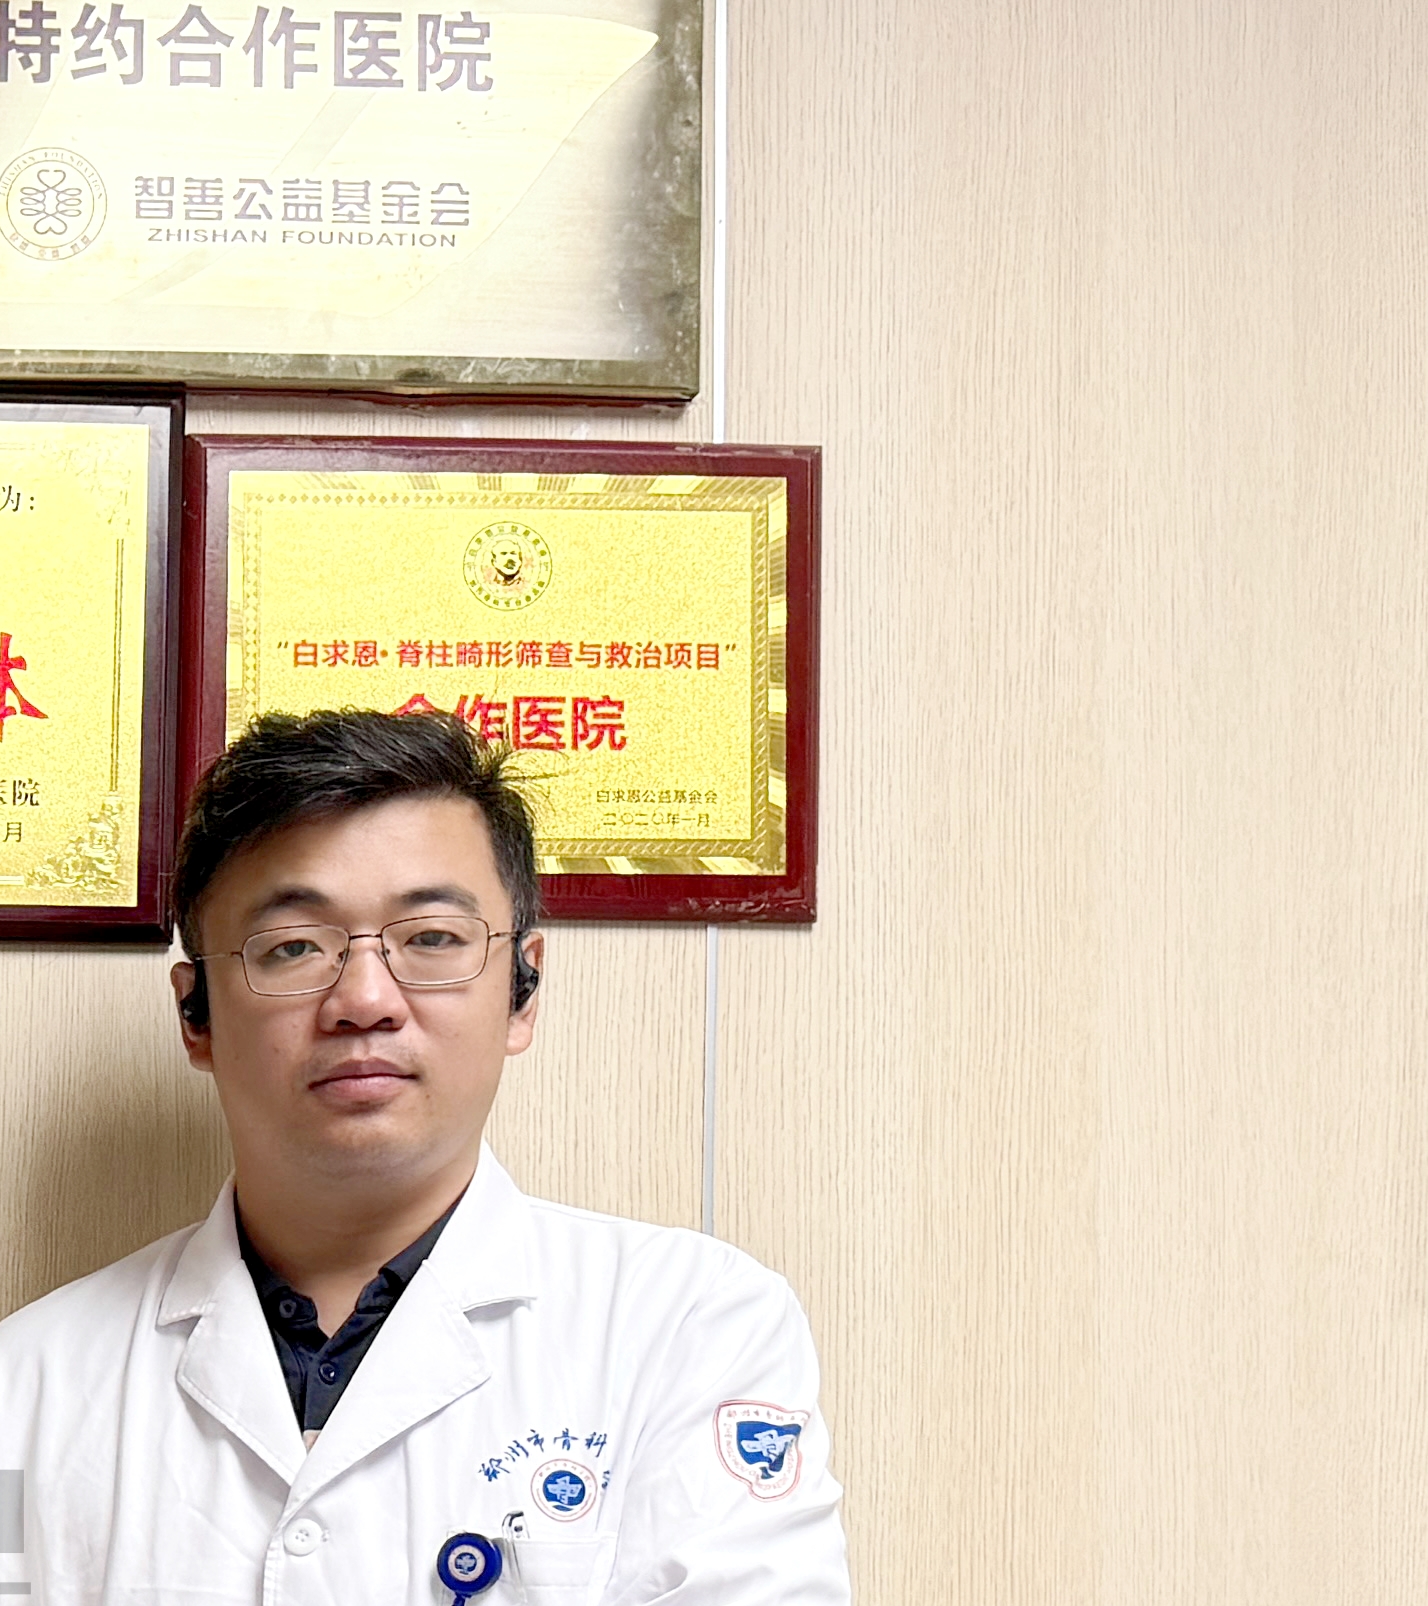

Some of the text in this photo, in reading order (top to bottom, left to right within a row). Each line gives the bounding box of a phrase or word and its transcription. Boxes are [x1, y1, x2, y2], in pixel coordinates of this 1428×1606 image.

[134, 175, 470, 227] 智善公益基金会
[147, 228, 456, 248] ZHISHAN FOUNDATION
[596, 789, 718, 804] 白求恩公益基金会
